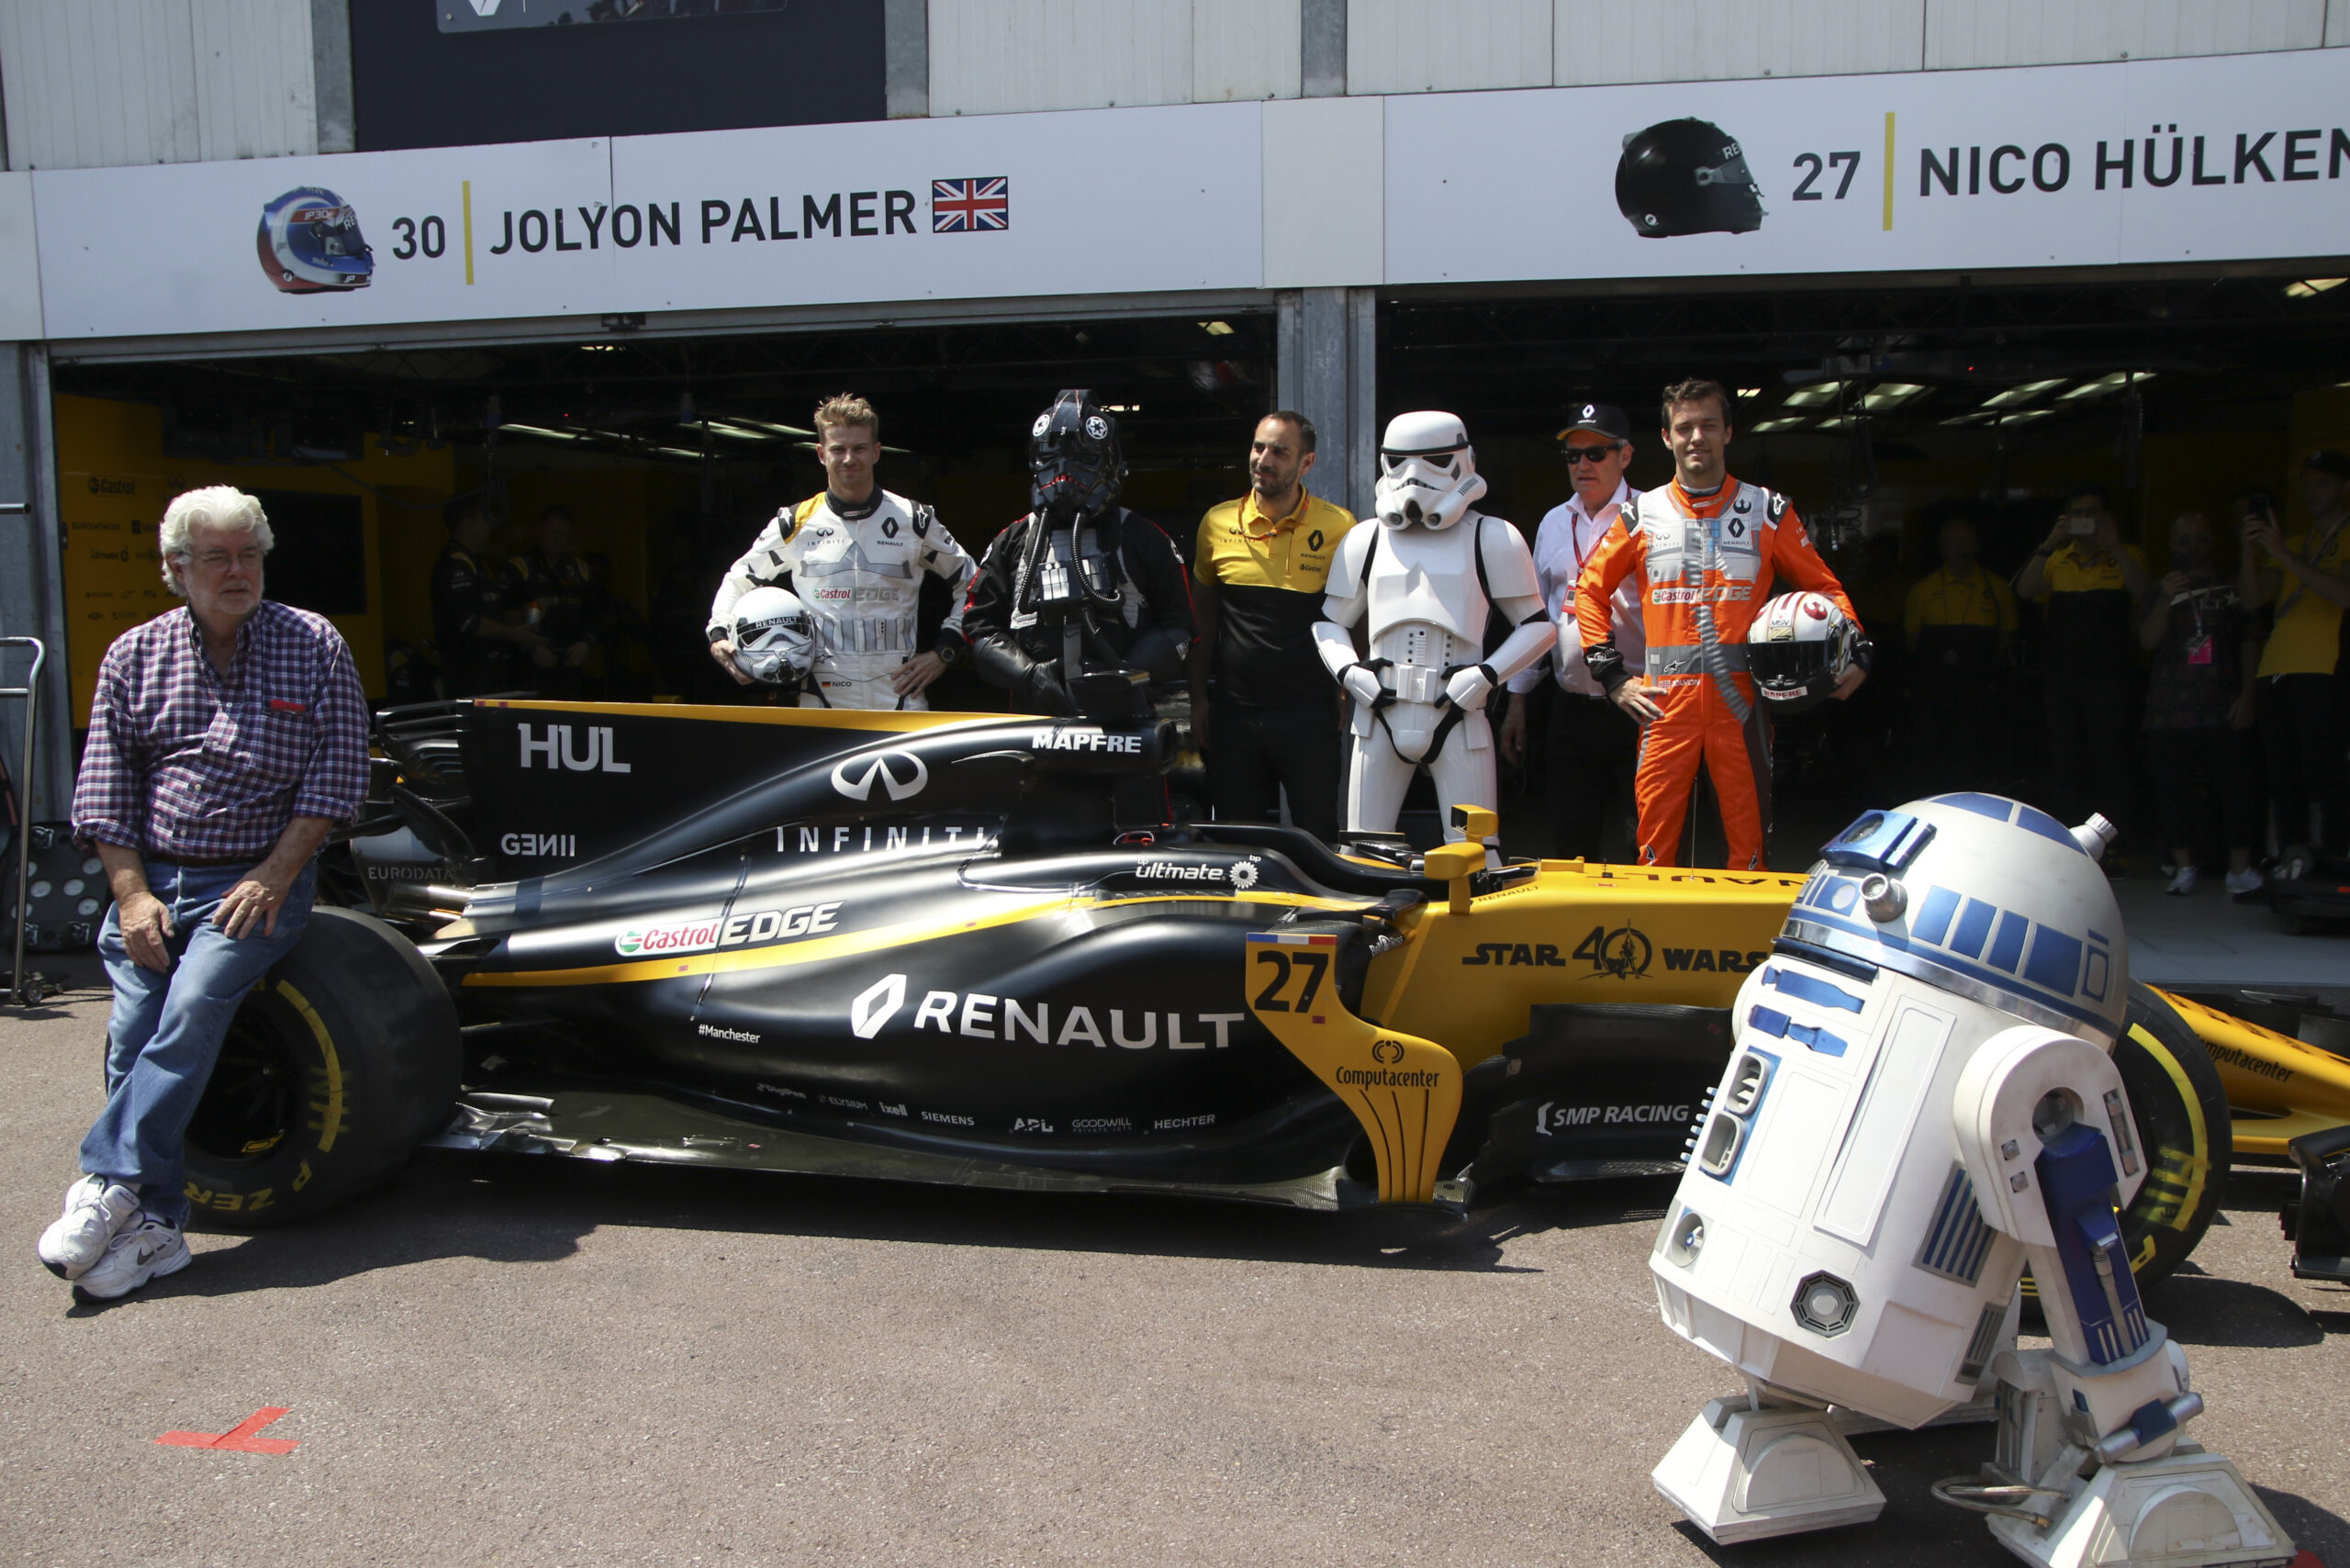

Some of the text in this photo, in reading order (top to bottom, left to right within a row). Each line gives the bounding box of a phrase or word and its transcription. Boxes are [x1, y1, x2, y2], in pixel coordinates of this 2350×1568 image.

[1793, 151, 1861, 201] 27
[1920, 143, 2070, 197] NICO
[392, 190, 918, 259] 30 JOLYON PALMER
[820, 588, 851, 600] Castrol
[1662, 586, 1753, 601] Castrol EDGE
[755, 617, 798, 628] RENAULT
[518, 722, 631, 773] HUL
[1032, 734, 1142, 753] MAPFRE
[1249, 854, 1261, 862] bp
[1136, 863, 1225, 880] ultimate
[643, 902, 845, 949] Castrol EDGE
[1462, 943, 1565, 967] STAR
[1254, 950, 1329, 1014] 27
[914, 991, 1244, 1049] RENAULT
[699, 1023, 760, 1044] #Manchester
[2197, 1034, 2294, 1081] mputacenter
[1337, 1066, 1439, 1091] Computacenter
[921, 1111, 975, 1126] SIEMENS
[1072, 1117, 1132, 1128] GOODWILL
[1154, 1114, 1215, 1129] HECHTER
[1553, 1104, 1689, 1126] SMP RACING
